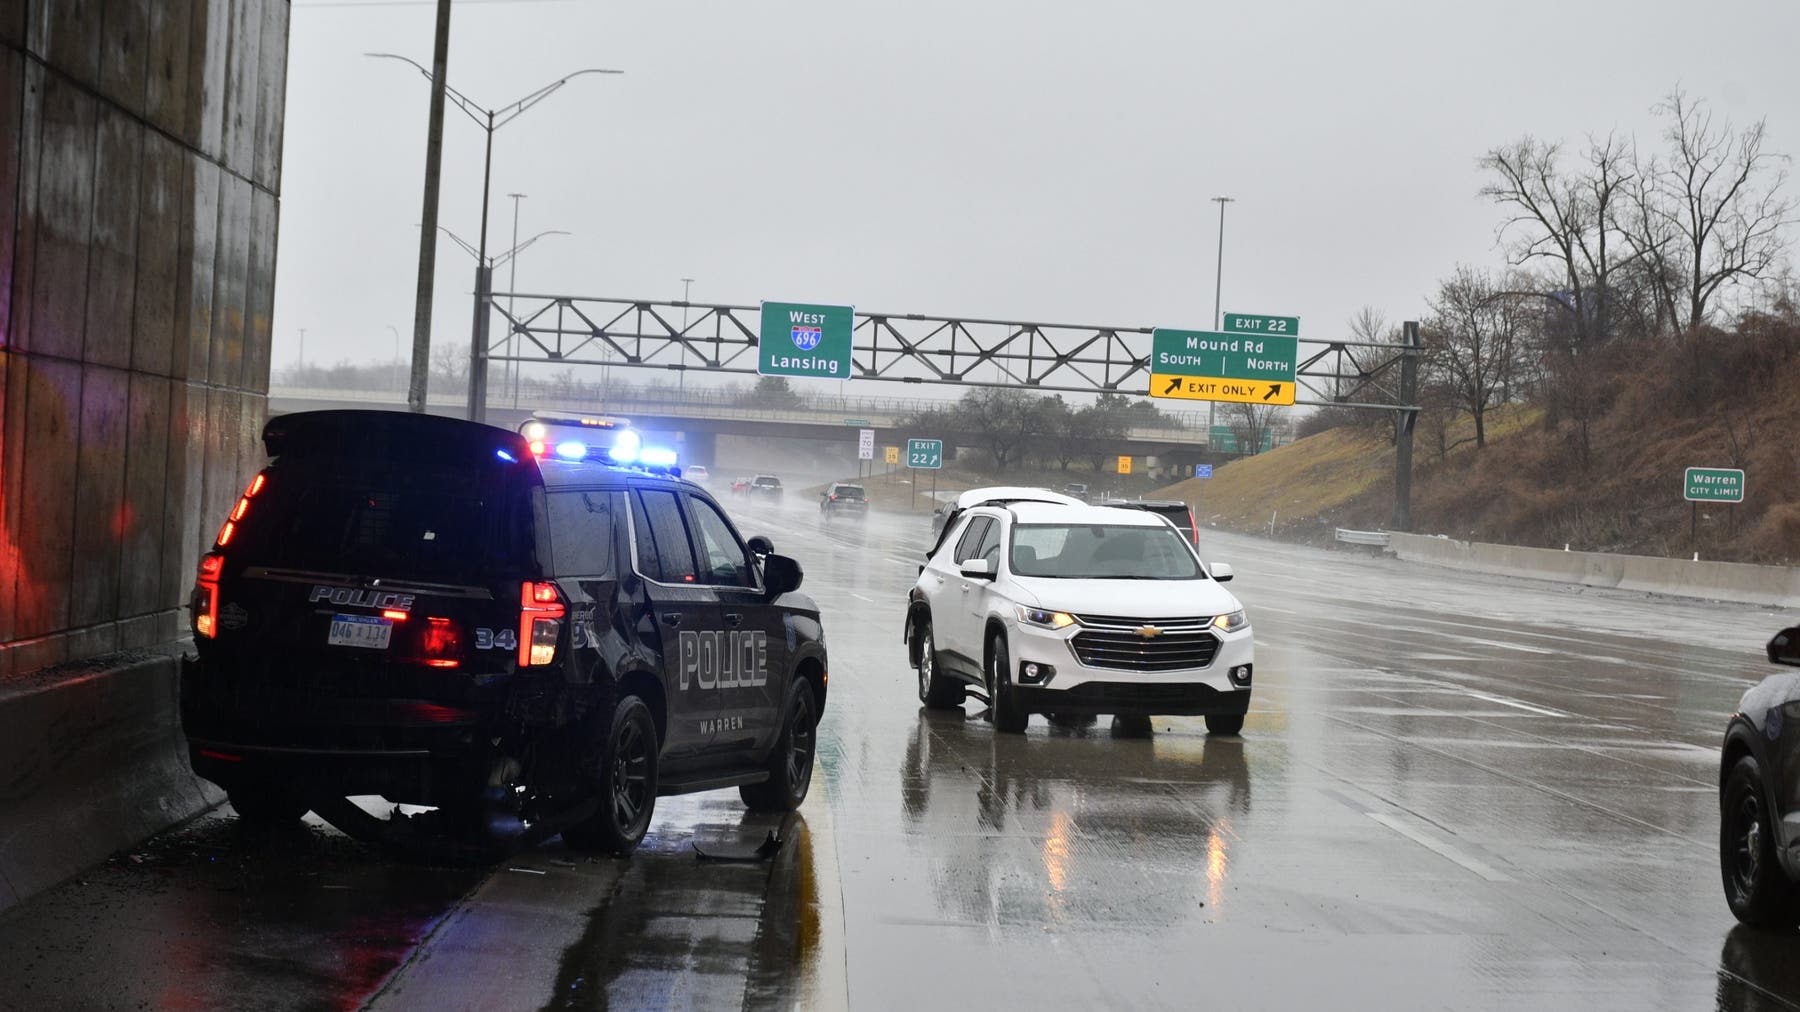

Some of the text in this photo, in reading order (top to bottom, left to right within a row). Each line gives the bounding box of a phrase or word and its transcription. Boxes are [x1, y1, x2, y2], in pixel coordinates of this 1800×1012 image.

[789, 311, 825, 324] WEST
[1235, 318, 1287, 332] EXIT 22
[796, 332, 816, 346] 696
[1187, 337, 1264, 354] Mound Rd
[771, 355, 838, 374] Lansing
[1160, 352, 1201, 366] SOUTH
[1247, 358, 1288, 371] NORTH
[1189, 383, 1256, 396] EXIT ONLY
[914, 441, 936, 450] EXIT
[912, 453, 927, 464] 22
[1693, 474, 1737, 485] Warren
[1690, 487, 1739, 496] CITY LIMIT
[308, 585, 416, 611] POLICE
[475, 628, 517, 650] 34
[679, 630, 768, 691] POLICE
[700, 716, 743, 735] WARREN
